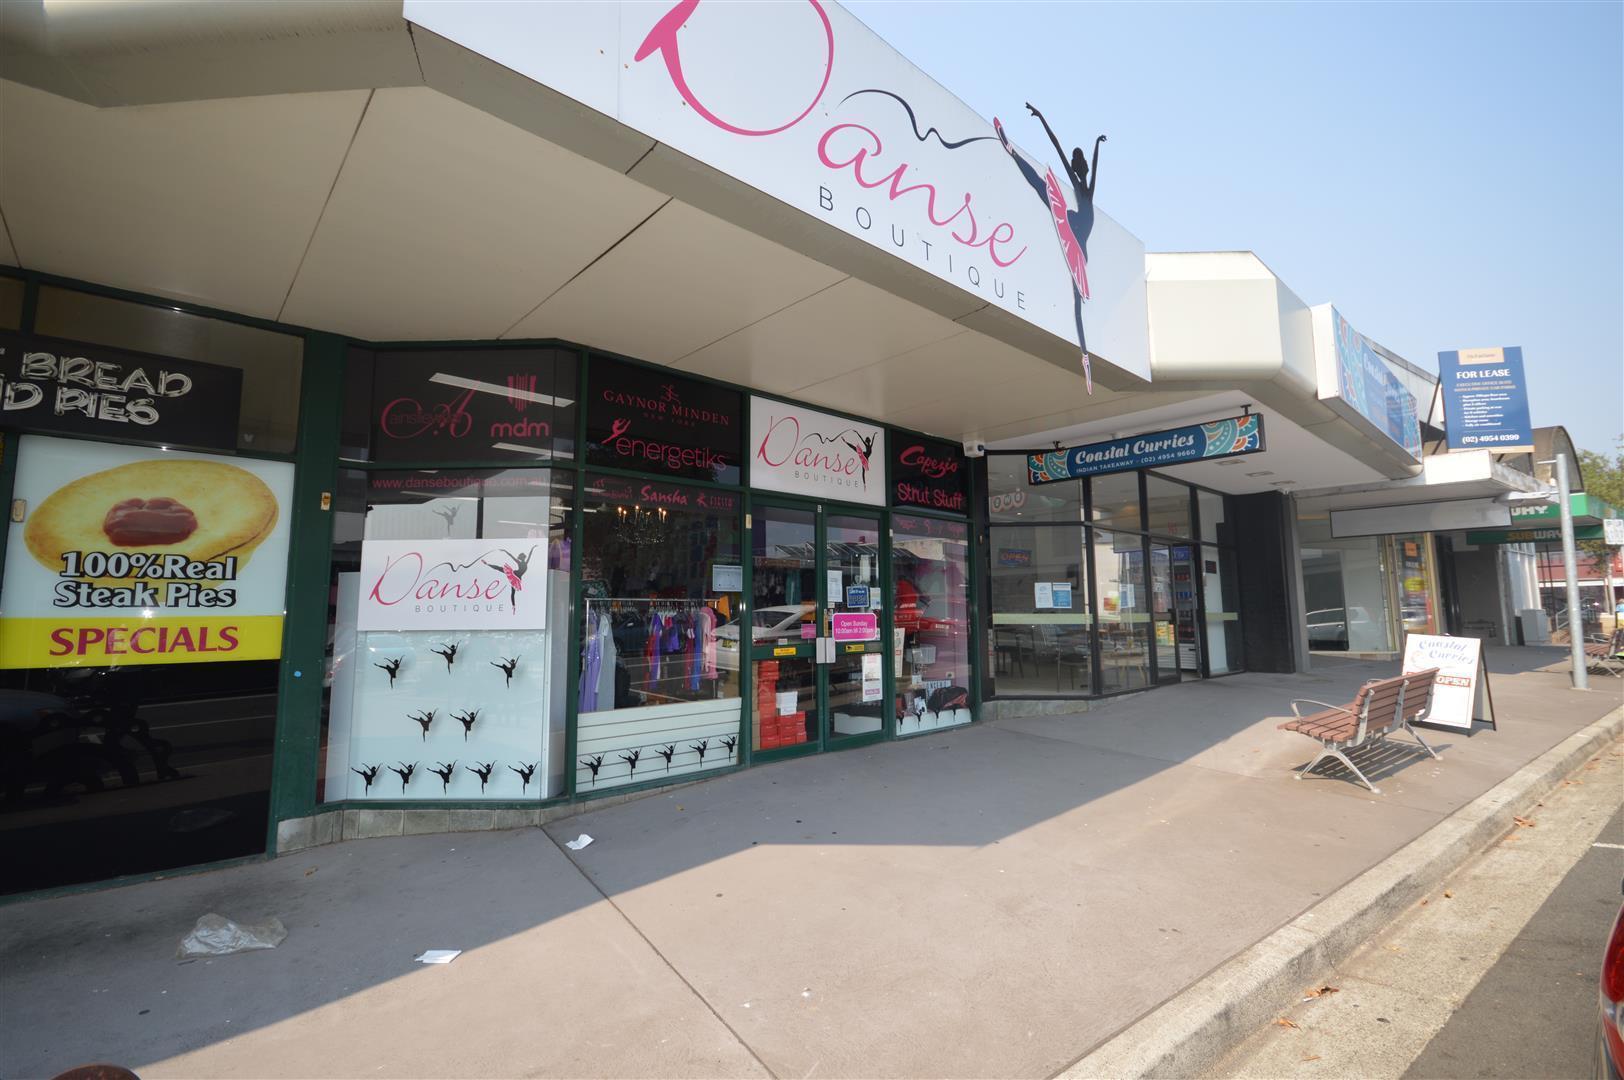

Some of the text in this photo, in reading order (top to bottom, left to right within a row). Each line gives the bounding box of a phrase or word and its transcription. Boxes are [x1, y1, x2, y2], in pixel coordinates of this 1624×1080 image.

[818, 185, 1026, 311] BOUTIQUE
[20, 352, 192, 398] BREAD
[1456, 368, 1511, 379] FOR LEASE
[54, 386, 160, 426] PIES
[603, 389, 730, 426] GAYNOR MINDEN
[490, 417, 549, 437] mdm
[1462, 436, 1478, 444] (02)
[615, 437, 727, 471] energetiks
[757, 415, 860, 476] Danse
[1075, 434, 1195, 465] Coastal Curries
[900, 445, 958, 479] Capezio
[1099, 460, 1134, 470] TAKEAWAY
[1140, 455, 1156, 464] (02)
[794, 470, 860, 488] BOUTIQUE
[640, 484, 689, 505] Sansha
[897, 482, 963, 510] Strut Stuff
[368, 552, 507, 606] Danse
[53, 580, 237, 608] Steak Pies
[414, 604, 505, 613] BOUTIQUE
[49, 626, 239, 656] SPECIALS
[1419, 640, 1467, 652] Coastal
[1429, 649, 1474, 665] Curries
[1436, 676, 1470, 687] OPEN
